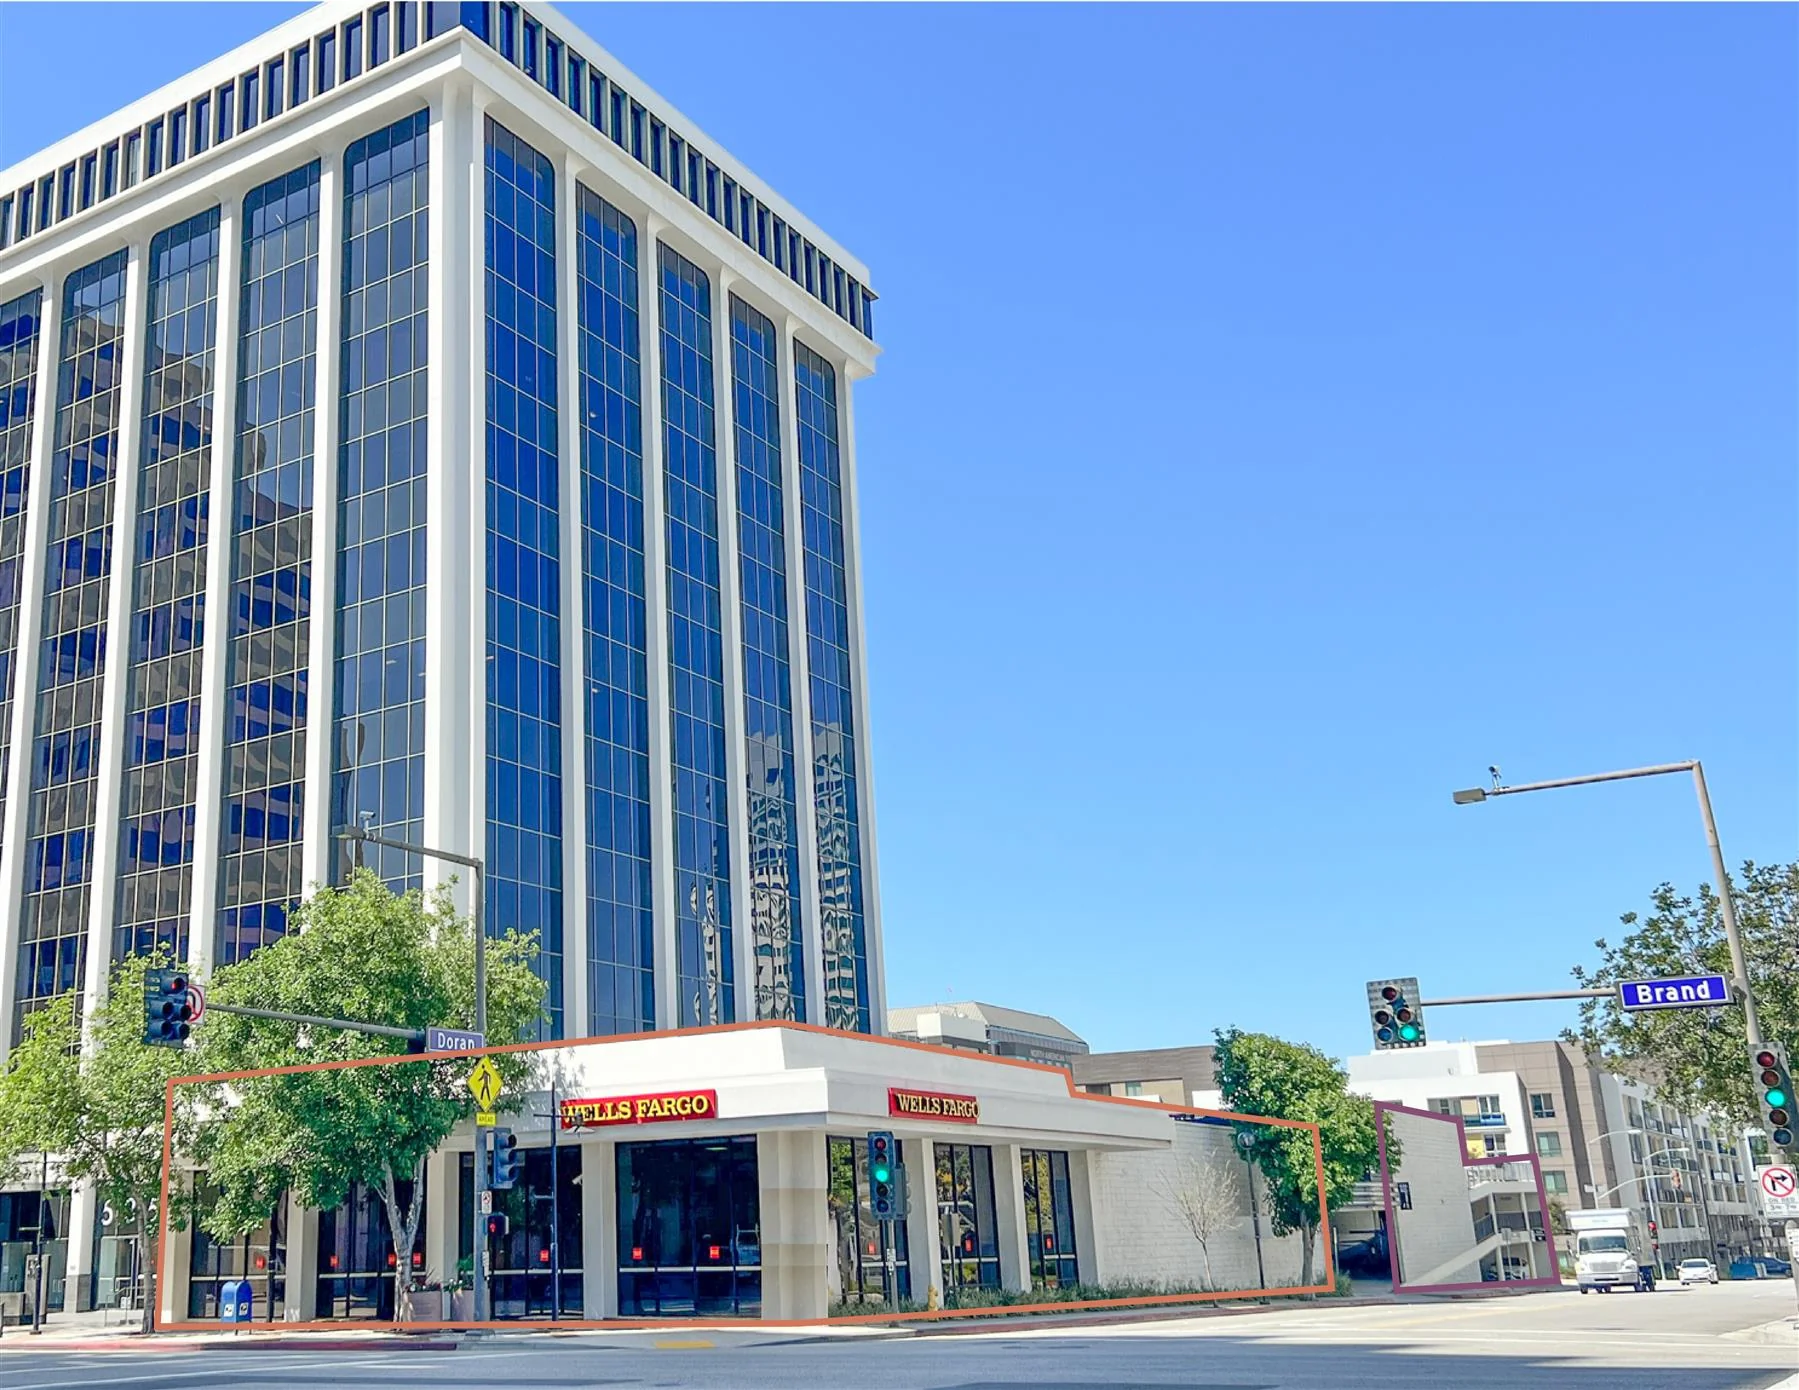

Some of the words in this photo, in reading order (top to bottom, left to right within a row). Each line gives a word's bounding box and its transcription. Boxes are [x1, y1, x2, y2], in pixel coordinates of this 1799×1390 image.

[1636, 980, 1711, 1003] Brand
[437, 1032, 475, 1050] Doran
[562, 1101, 632, 1123] WELLS
[636, 1095, 709, 1118] FARGO
[897, 1093, 941, 1115] WELLS
[942, 1098, 980, 1119] FARGO
